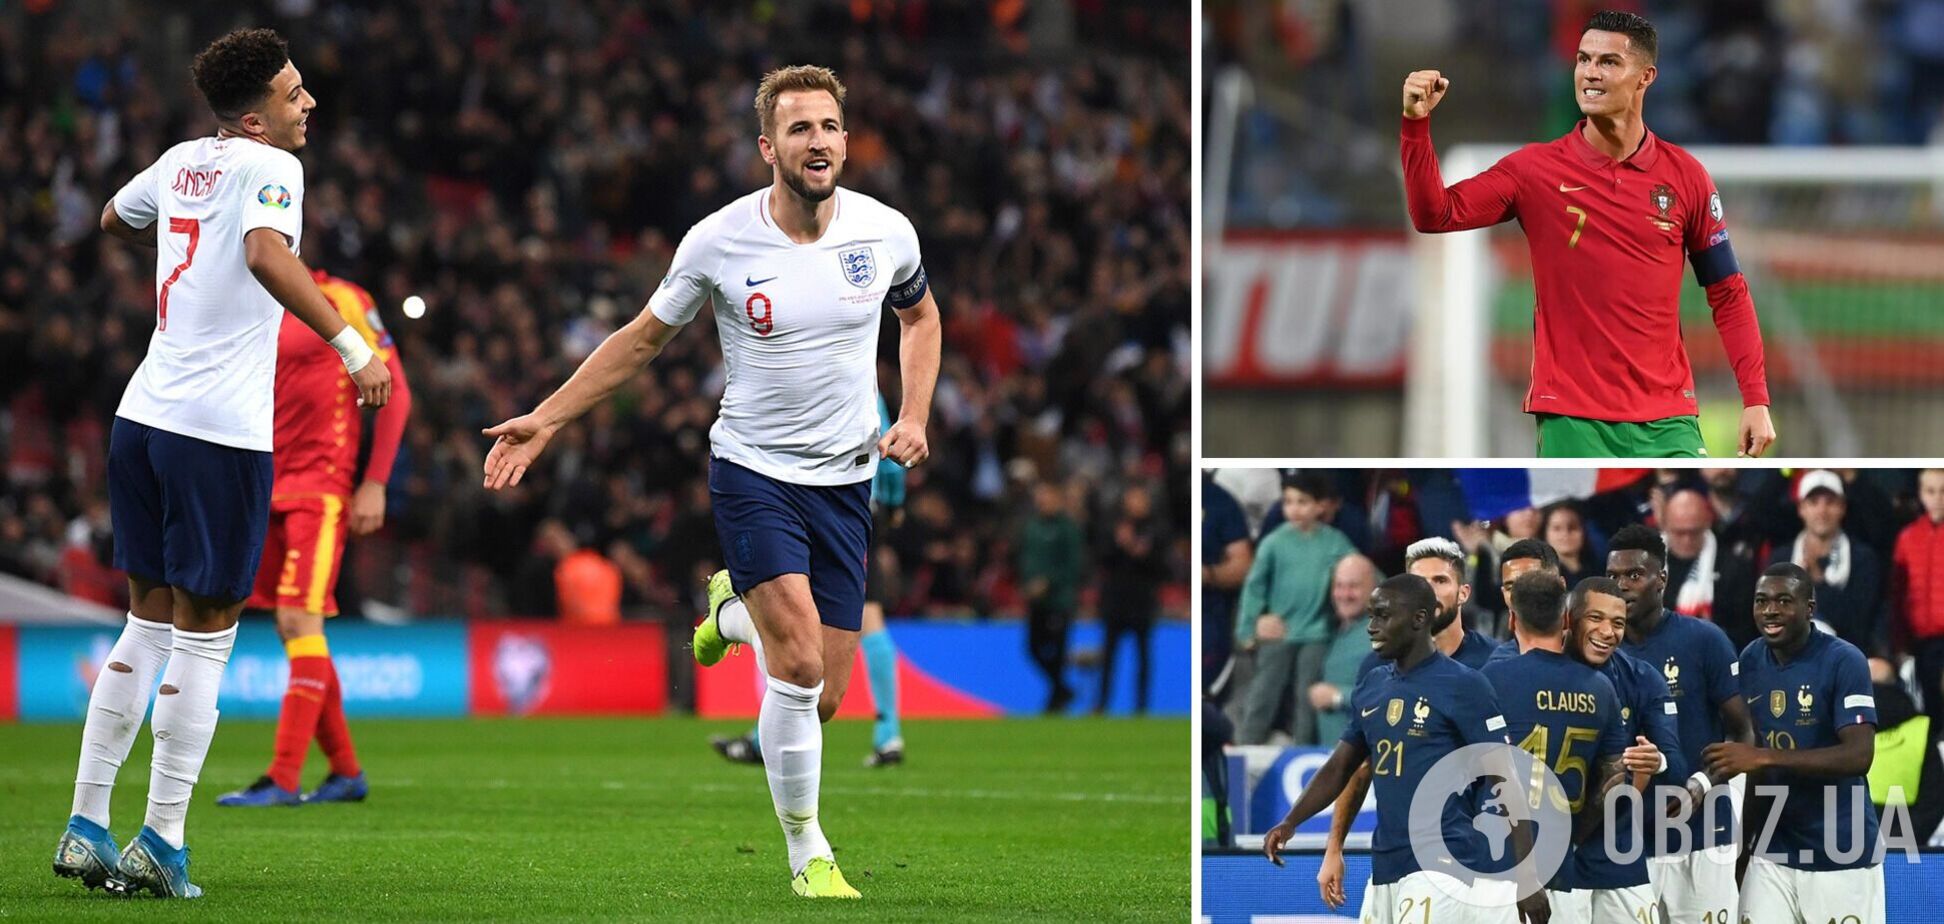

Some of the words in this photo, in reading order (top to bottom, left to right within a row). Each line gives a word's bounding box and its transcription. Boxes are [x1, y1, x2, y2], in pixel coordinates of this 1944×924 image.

[1565, 205, 1588, 249] 7
[159, 216, 200, 332] 7
[745, 291, 774, 337] 9
[1536, 690, 1596, 714] CLAUSS
[1375, 739, 1404, 777] 21
[1516, 722, 1600, 815] 15
[1399, 896, 1431, 924] 21
